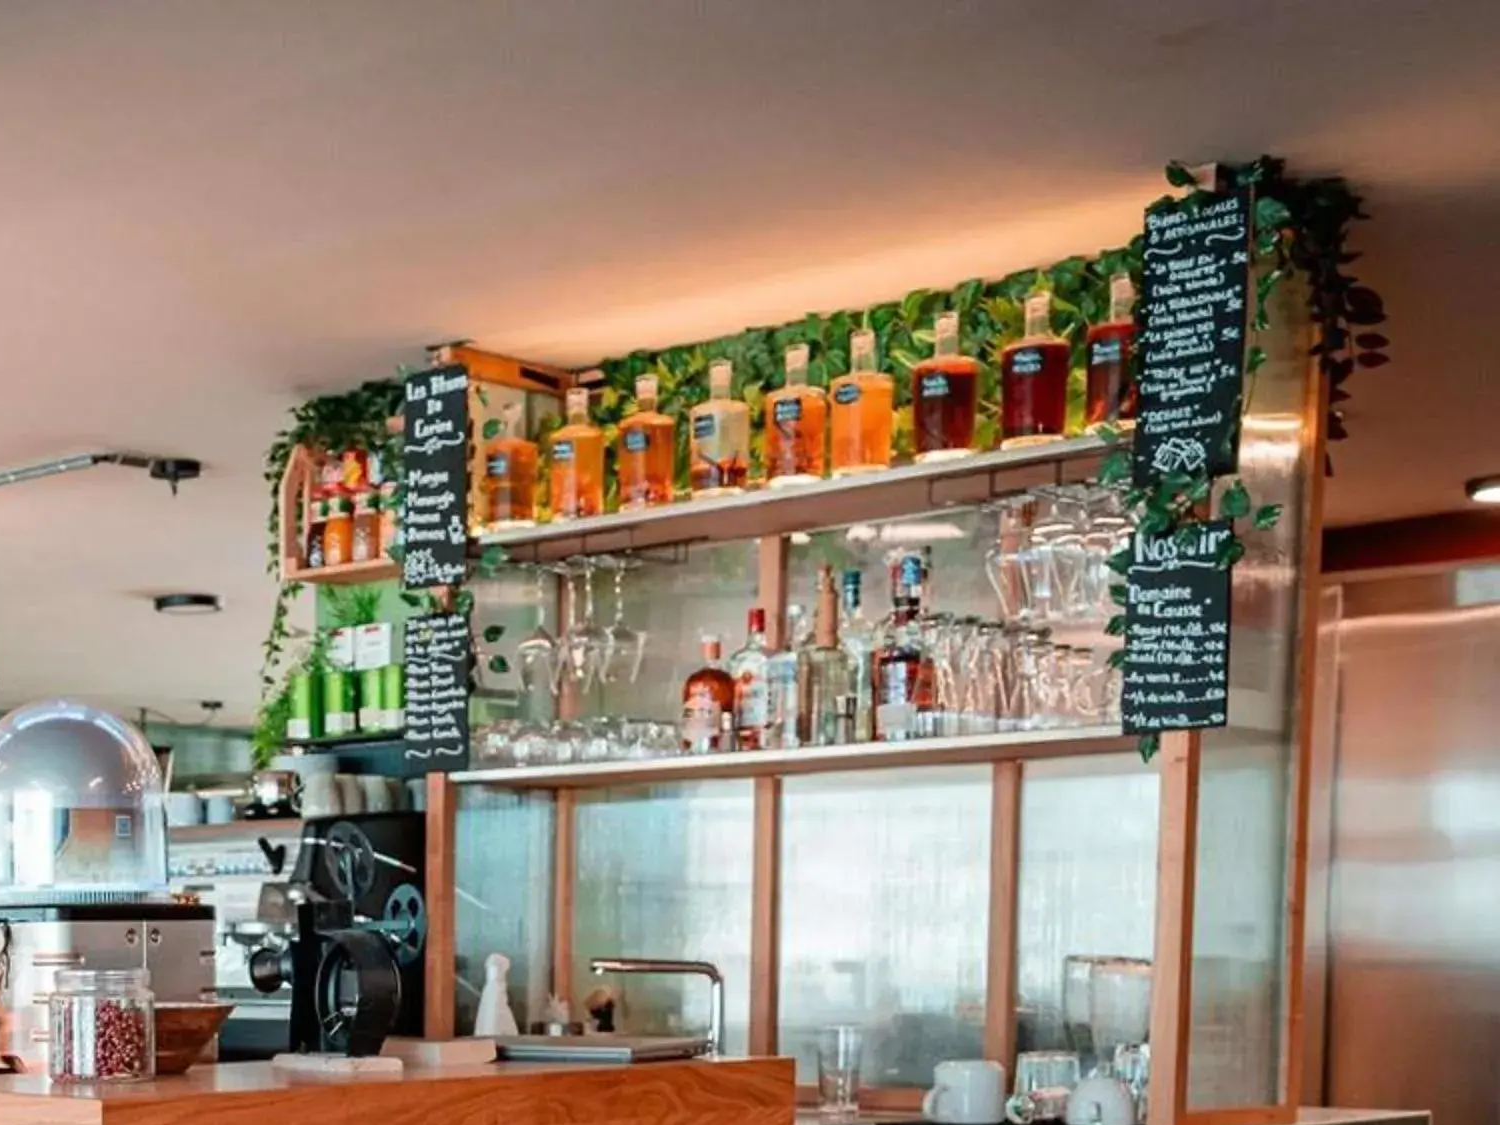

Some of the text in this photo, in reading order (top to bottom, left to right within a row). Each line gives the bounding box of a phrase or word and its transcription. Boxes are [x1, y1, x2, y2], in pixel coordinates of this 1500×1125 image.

[1134, 533, 1178, 563] Nos
[1127, 583, 1192, 604] Domaine
[1153, 600, 1203, 619] Causse
